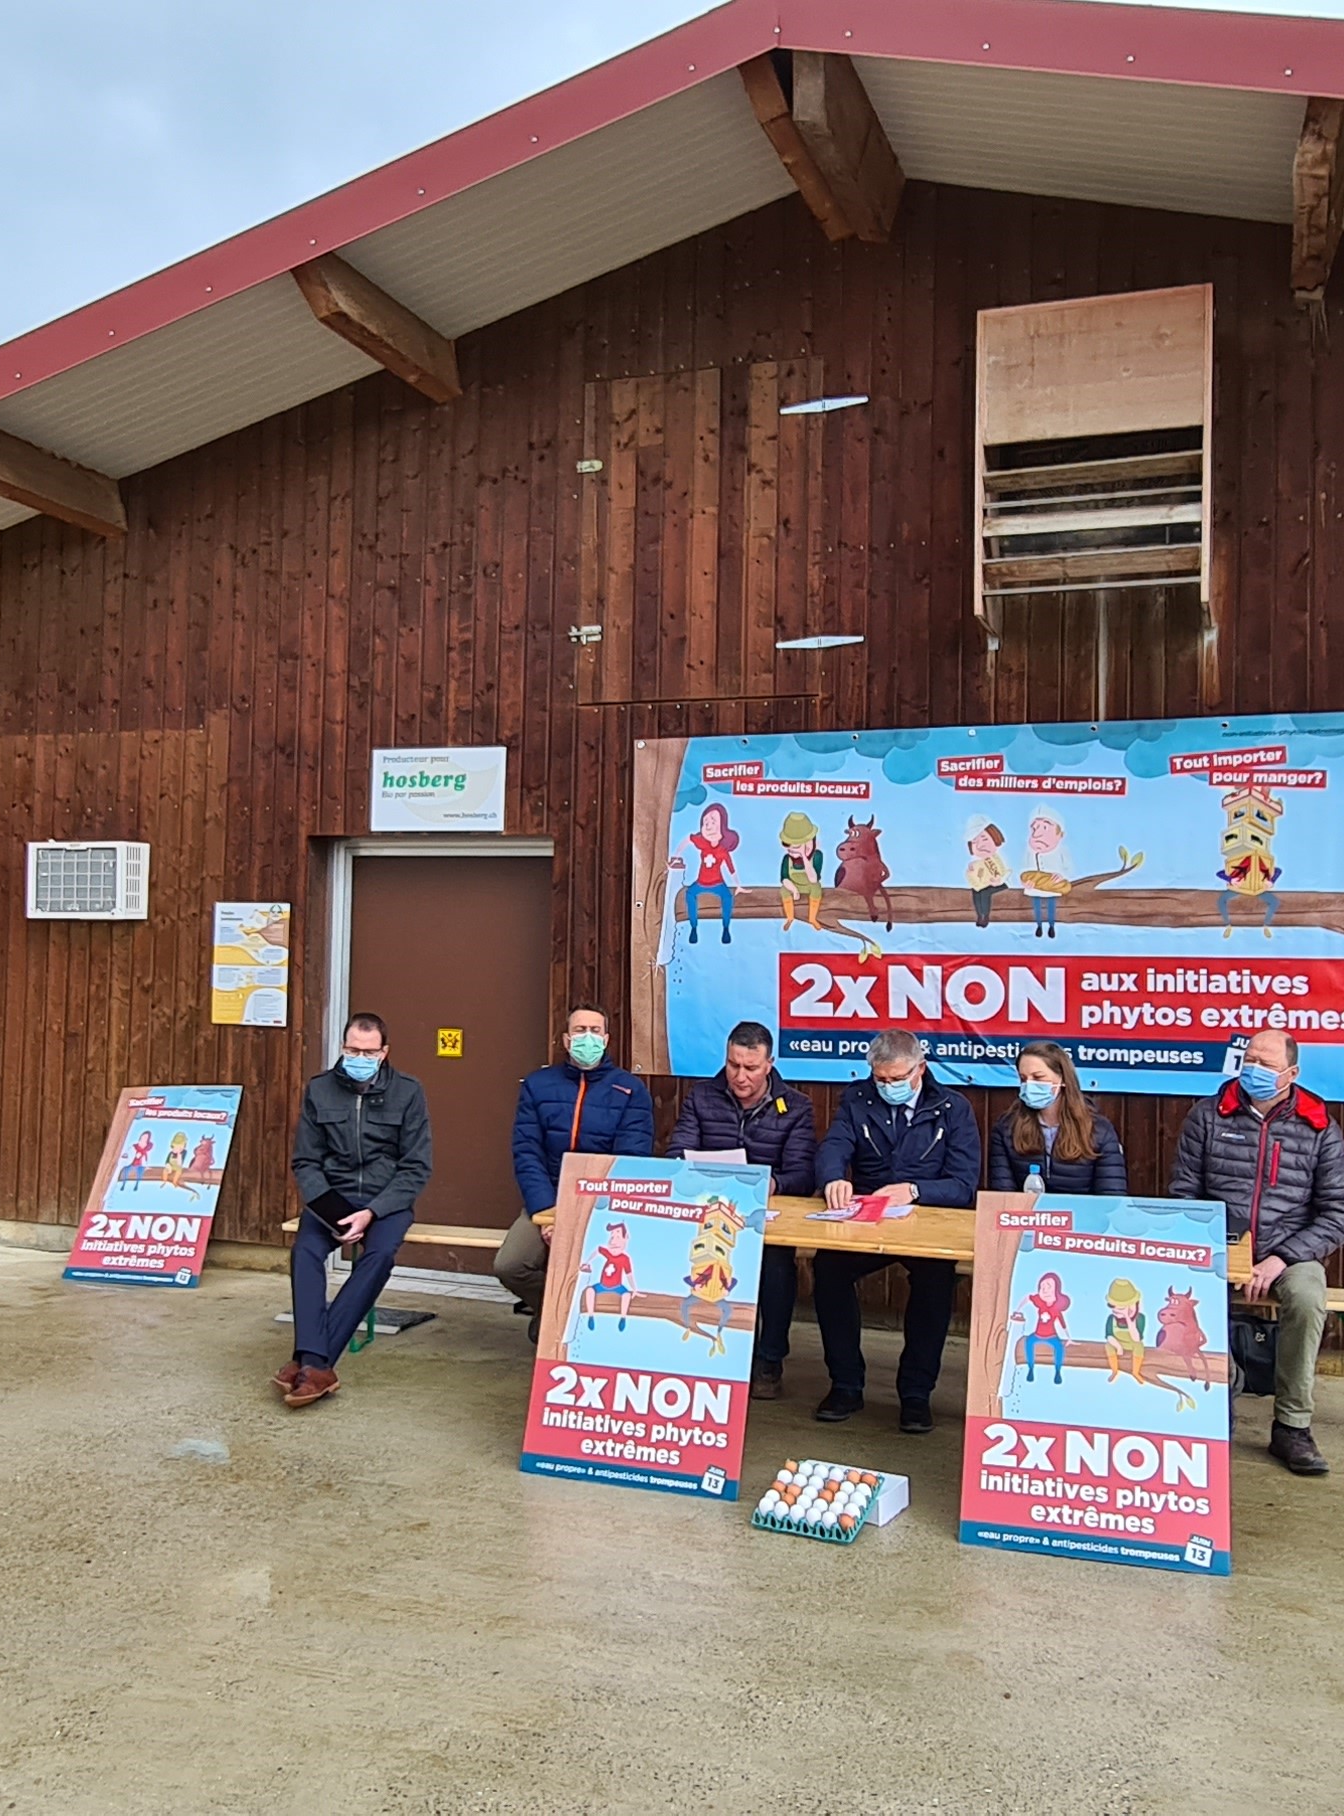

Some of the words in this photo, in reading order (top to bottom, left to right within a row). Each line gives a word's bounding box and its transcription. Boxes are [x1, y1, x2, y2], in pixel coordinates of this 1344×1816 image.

[940, 758, 1000, 772] Sacrifier
[1173, 755, 1210, 770] Tout
[1213, 750, 1282, 767] importer
[382, 770, 467, 791] hosberg
[706, 765, 760, 778] Sacrifier
[1212, 770, 1249, 783] pour
[1253, 772, 1323, 785] manger?
[736, 781, 754, 792] les
[757, 782, 812, 794] produits
[815, 782, 866, 795] locaux?
[958, 775, 983, 787] des
[987, 776, 1038, 789] milliers
[1041, 777, 1123, 793] d'emplois?
[1081, 972, 1138, 992] aux
[1146, 968, 1309, 996] initiatives
[790, 963, 879, 1018] 2x
[888, 964, 1066, 1023] NON
[1081, 1000, 1192, 1030] phytos
[789, 1039, 833, 1052] «eau
[919, 1039, 931, 1055] &
[1078, 1045, 1204, 1065] trompeuses
[578, 1180, 608, 1192] Tout
[610, 1181, 668, 1195] importer
[611, 1199, 642, 1210] pour
[644, 1203, 703, 1219] manger?
[85, 1214, 126, 1238] 2x
[125, 1215, 201, 1242] NON
[1000, 1214, 1068, 1227] Sacrifier
[81, 1239, 145, 1254] initiatives
[147, 1243, 195, 1257] phytos
[1038, 1232, 1061, 1246] les
[1065, 1235, 1136, 1254] produits
[1140, 1243, 1206, 1262] locaux?
[102, 1255, 165, 1268] extrêmes
[545, 1365, 608, 1410] 2x
[613, 1372, 732, 1425] NON
[542, 1407, 646, 1437] initiatives
[650, 1422, 728, 1448] phytos
[581, 1438, 680, 1465] extrêmes
[982, 1423, 1056, 1472] 2x
[1065, 1430, 1208, 1489] NON
[708, 1477, 720, 1489] 13
[980, 1470, 1109, 1503] initiatives
[1116, 1486, 1210, 1515] phytos
[1030, 1504, 1155, 1535] extrêmes
[1042, 1536, 1050, 1545] &
[1051, 1538, 1119, 1554] antipesticides
[1120, 1546, 1180, 1562] trompeuses
[1191, 1548, 1206, 1561] 13
